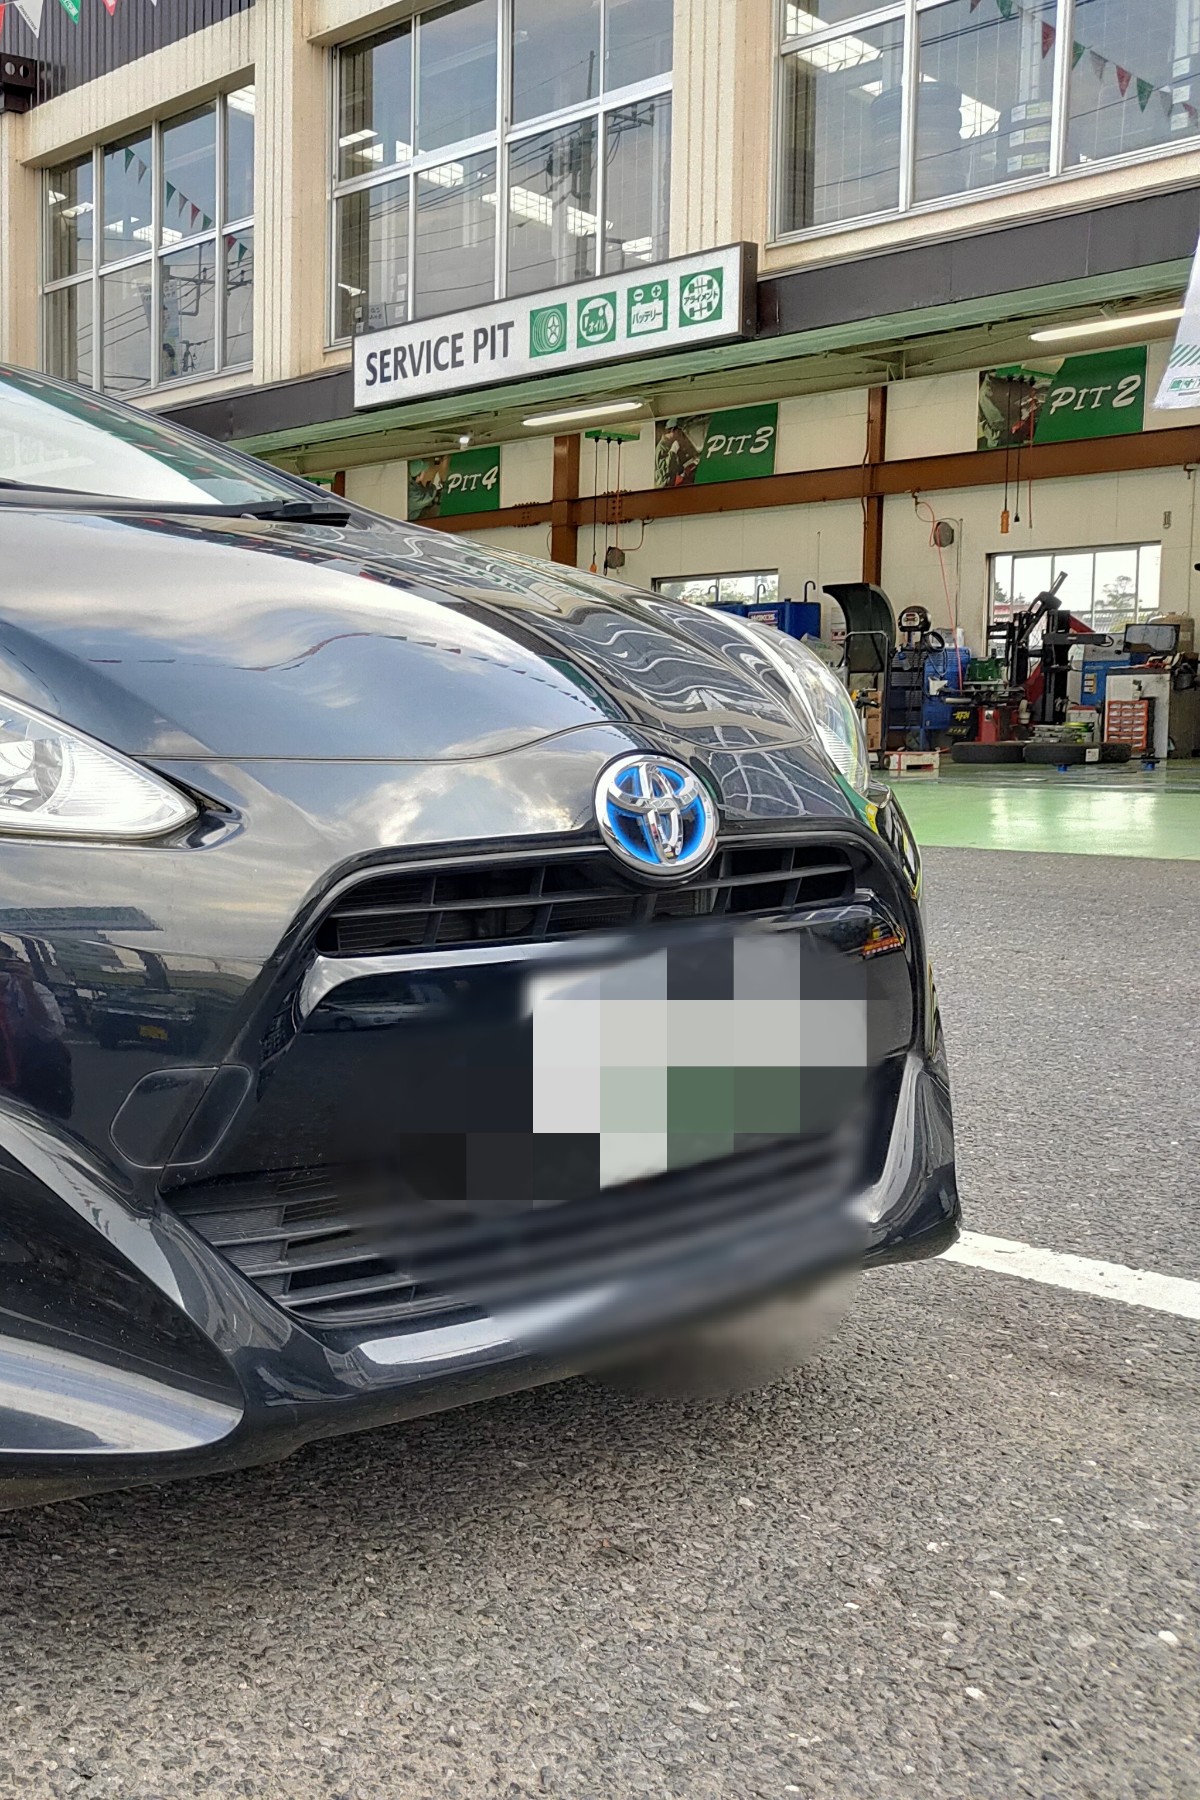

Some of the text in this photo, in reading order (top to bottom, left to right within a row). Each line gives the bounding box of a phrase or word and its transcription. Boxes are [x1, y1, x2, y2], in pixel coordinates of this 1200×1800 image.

[684, 291, 719, 306] アライメント
[588, 318, 606, 333] オイル
[632, 309, 663, 325] バッテリー
[365, 320, 515, 387] SERVICE PIT
[1050, 374, 1141, 415] PIT 2
[706, 426, 774, 459] PIT 3
[447, 465, 498, 494] PIT 4
